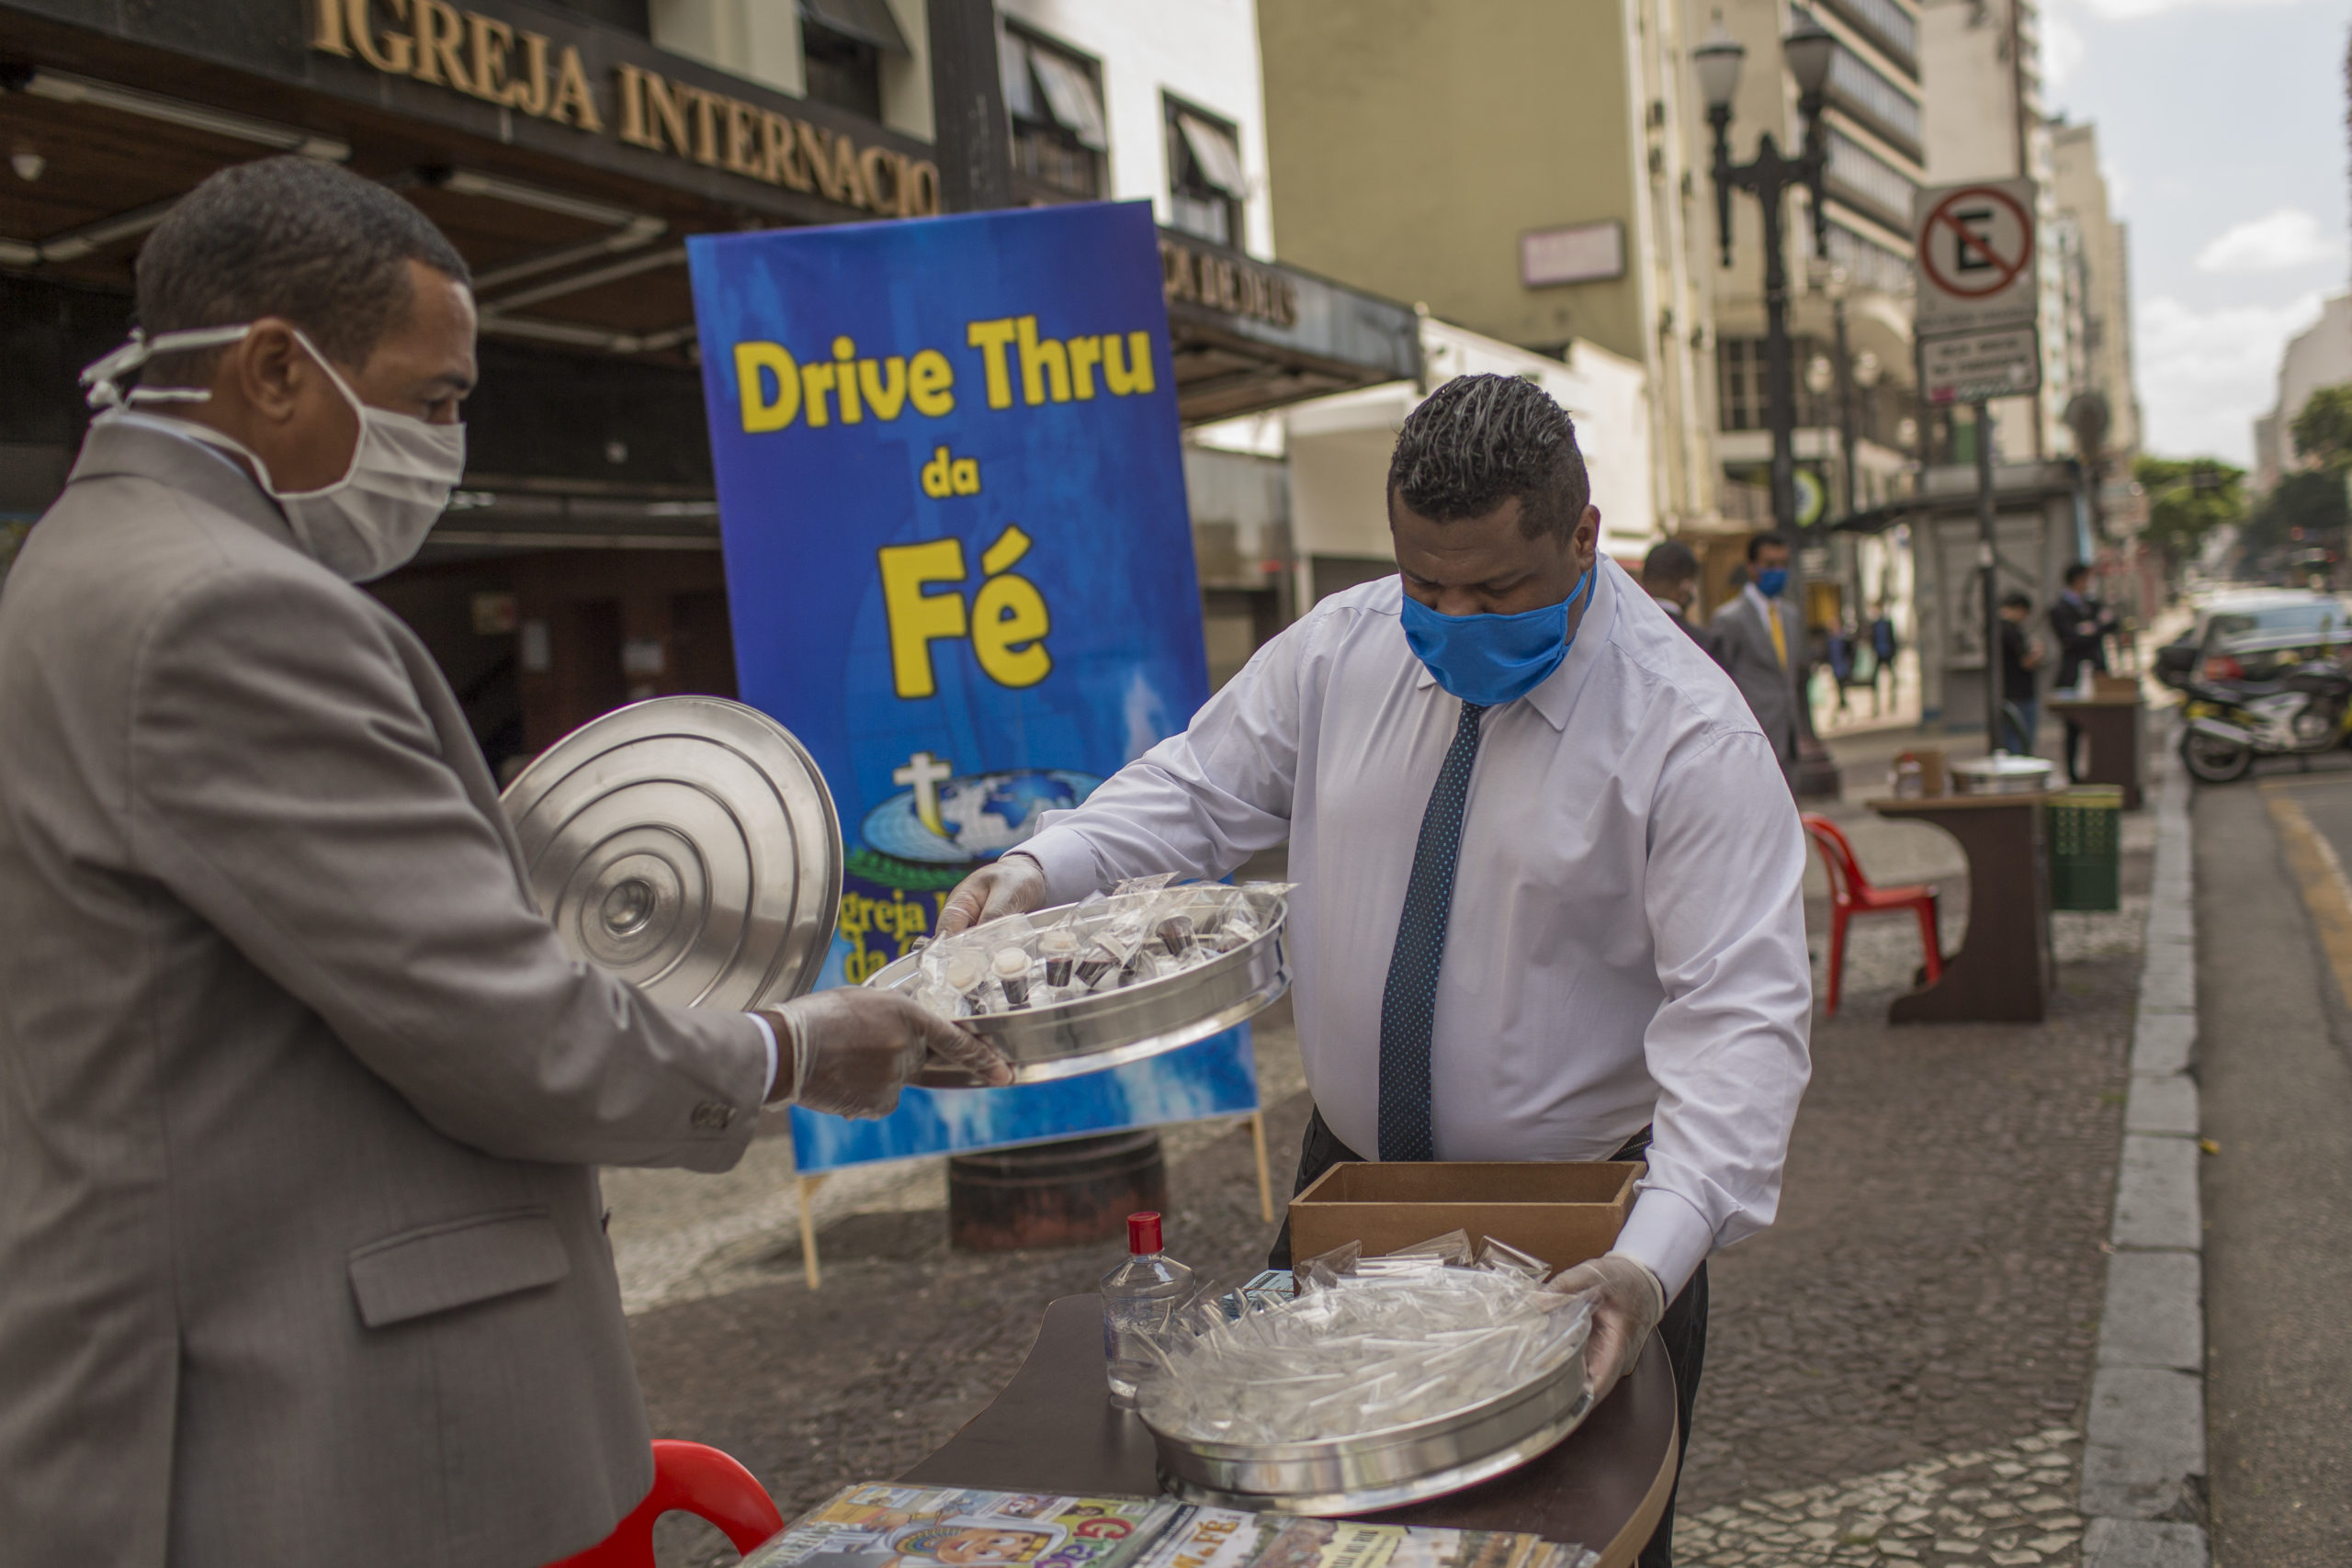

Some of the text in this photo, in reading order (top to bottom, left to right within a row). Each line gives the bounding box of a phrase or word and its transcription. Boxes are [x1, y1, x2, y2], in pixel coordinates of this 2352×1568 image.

[311, 0, 605, 134] IGREJA
[734, 315, 1156, 434] Drive Thru
[922, 446, 981, 499] da
[878, 525, 1055, 701] Fé
